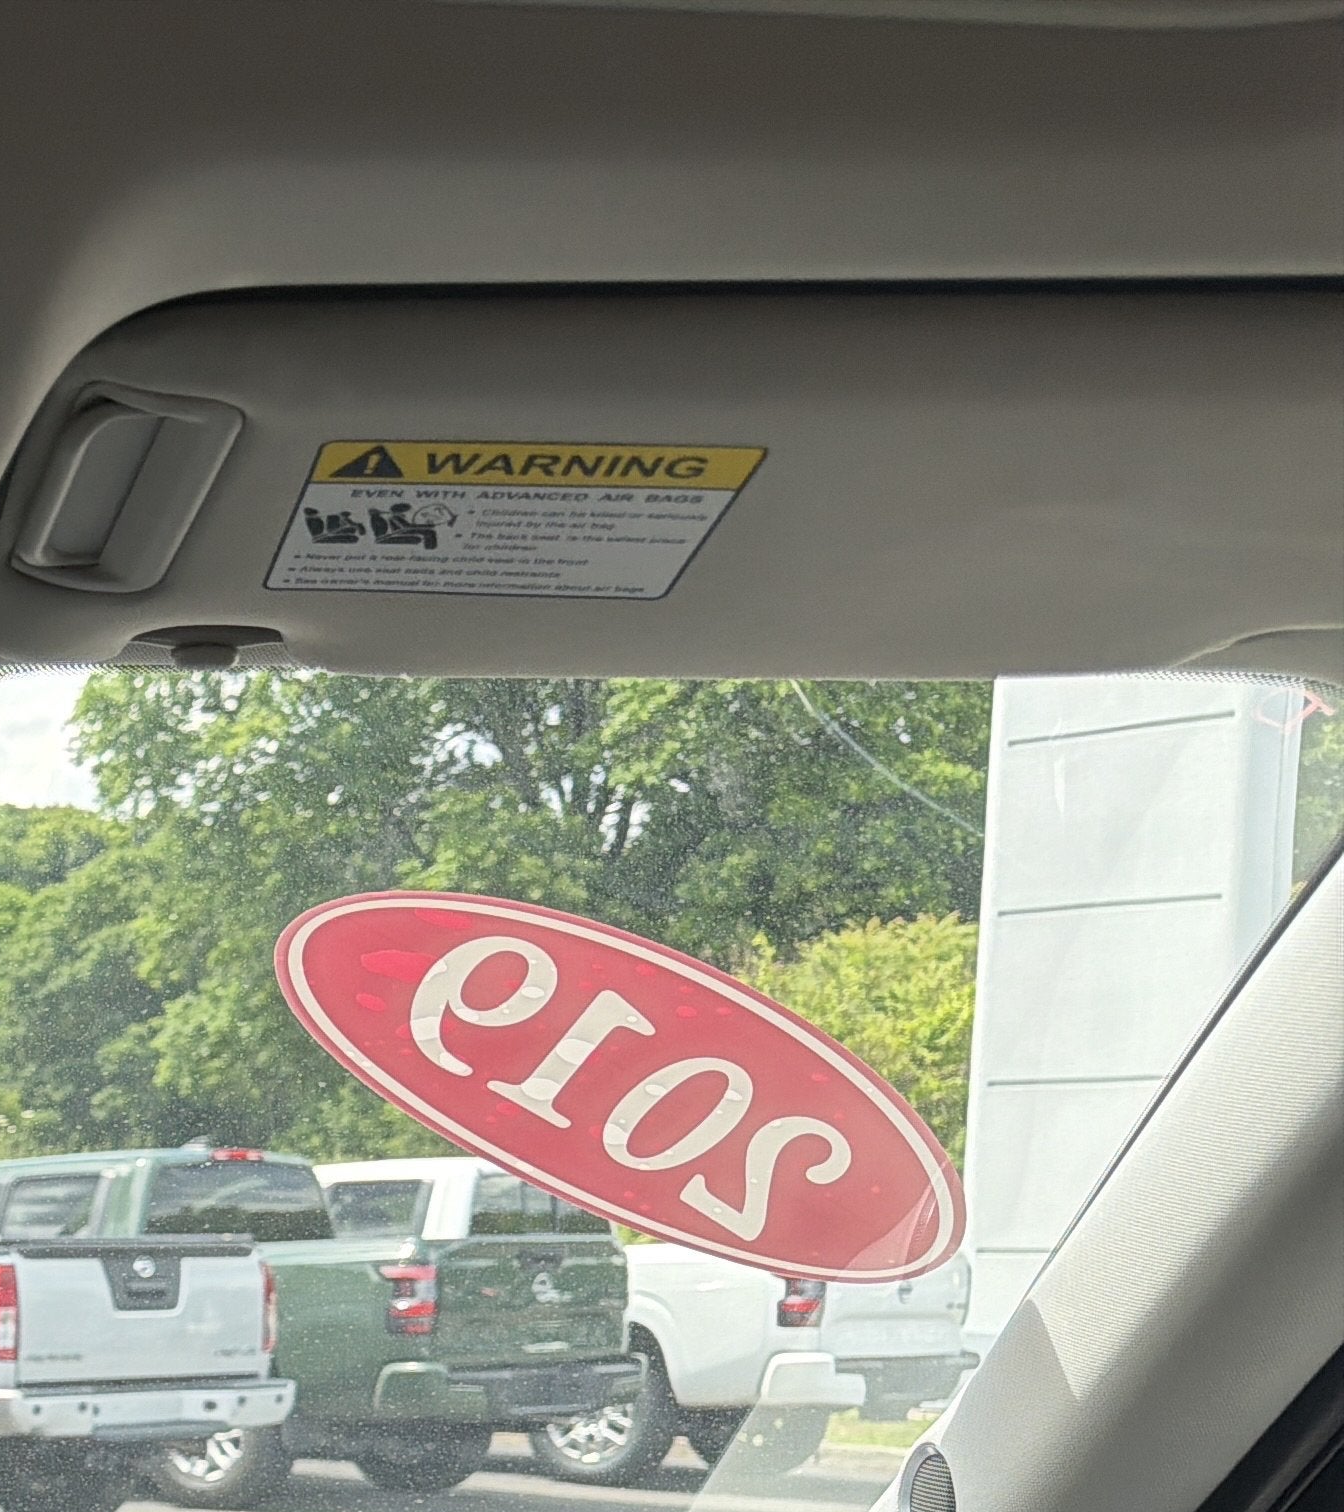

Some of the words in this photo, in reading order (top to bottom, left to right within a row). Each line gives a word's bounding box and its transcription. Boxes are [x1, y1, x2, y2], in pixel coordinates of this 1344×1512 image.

[427, 452, 710, 480] WARNING
[350, 489, 405, 498] EVEN
[416, 490, 466, 499] WITH
[477, 491, 588, 501] ADVANCED
[598, 493, 633, 503] AIR
[645, 494, 704, 504] BAGS
